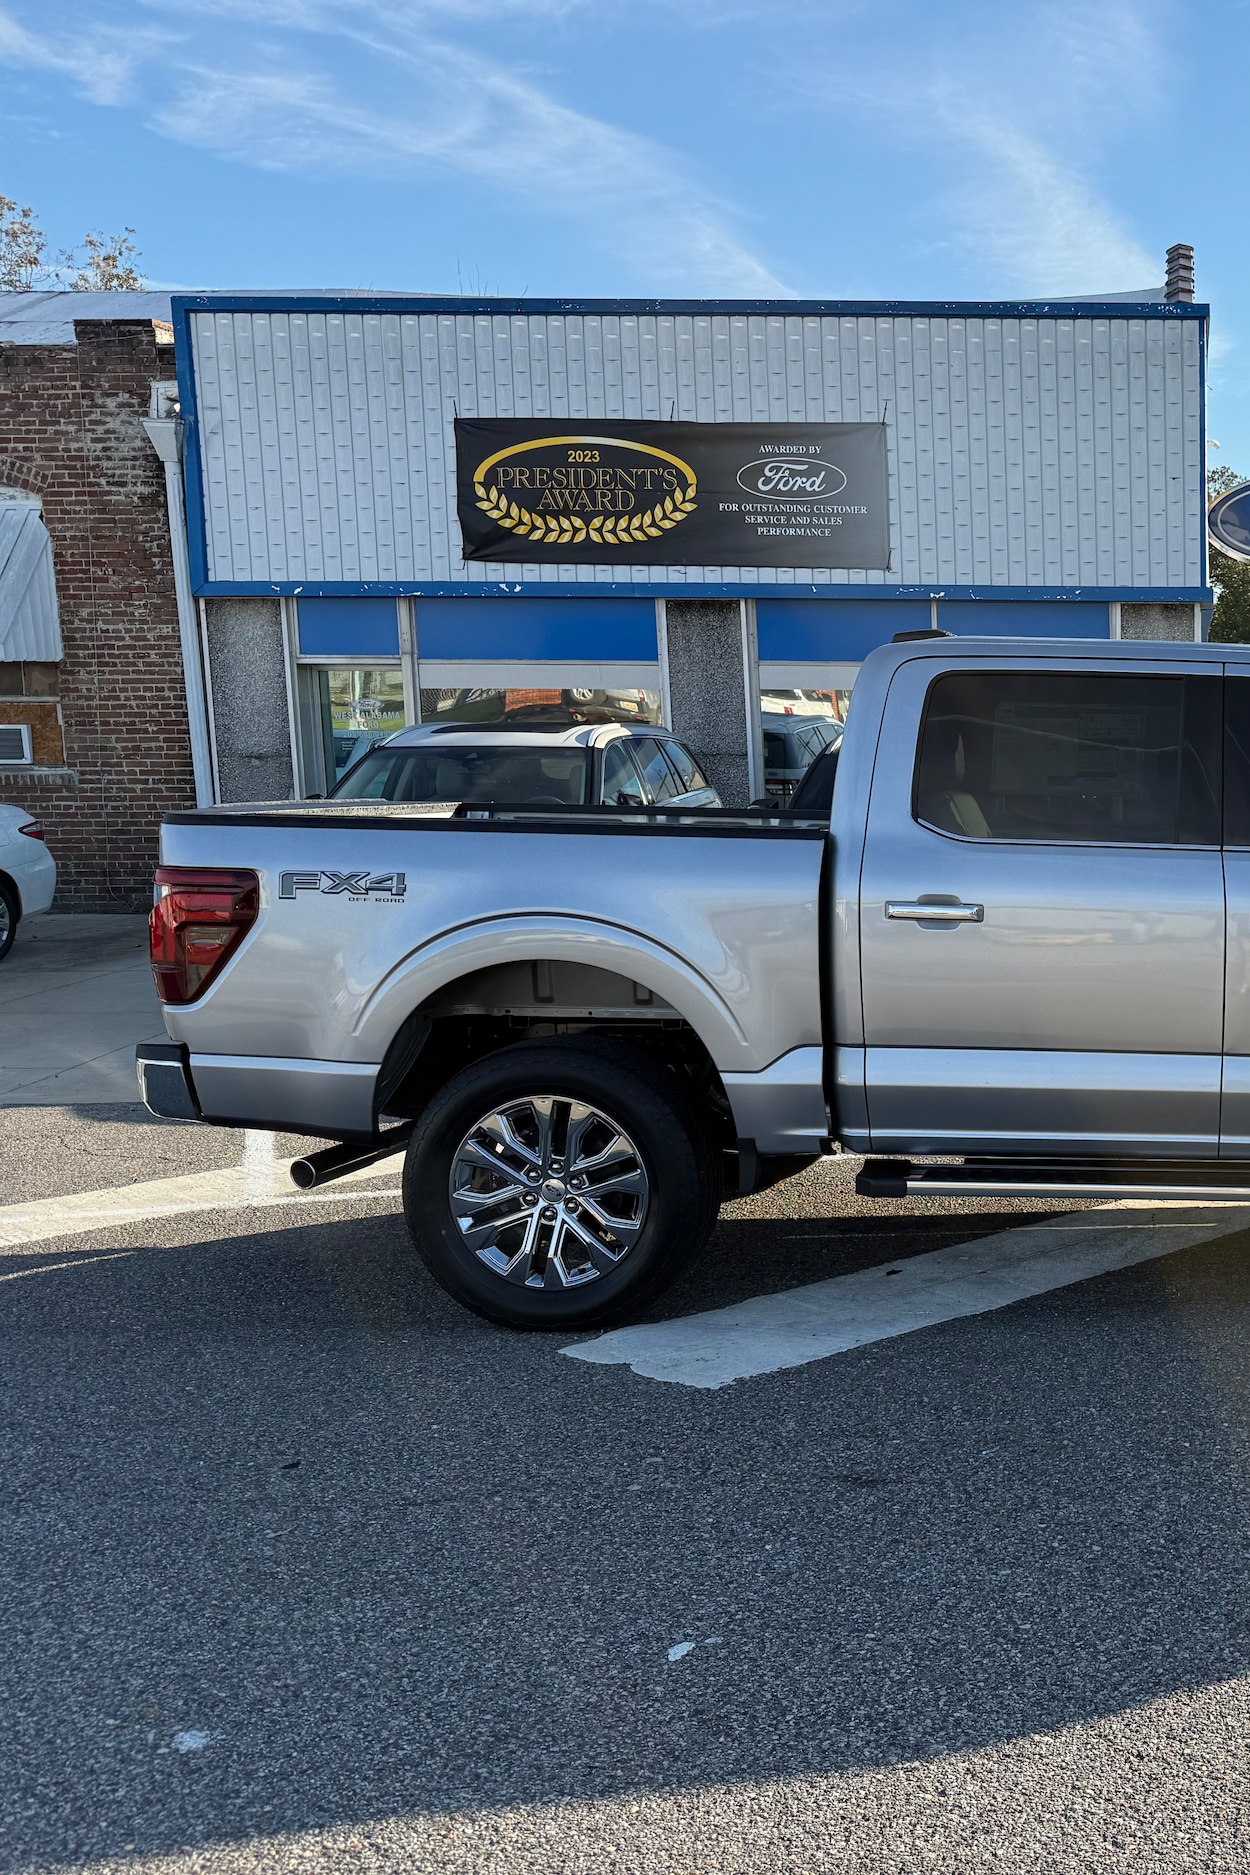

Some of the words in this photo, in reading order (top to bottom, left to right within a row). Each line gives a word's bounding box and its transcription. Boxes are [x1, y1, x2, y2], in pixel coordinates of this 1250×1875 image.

[758, 445, 806, 454] AWARDED
[809, 446, 822, 454] BY
[567, 450, 600, 463] 2023
[496, 467, 678, 490] PRESIDENT'S
[757, 462, 826, 492] Ford
[536, 489, 635, 512] AWARD
[718, 503, 739, 512] FOR
[741, 503, 811, 513] OUTSTANDING
[813, 505, 868, 514] CUSTOMER
[744, 515, 788, 525] SERVICE
[789, 516, 810, 525] AND
[812, 516, 843, 525] SALES
[757, 527, 832, 537] PERFORMANCE
[360, 711, 401, 720] ALABAMA
[357, 720, 379, 729] FORD
[279, 870, 407, 899] FX4
